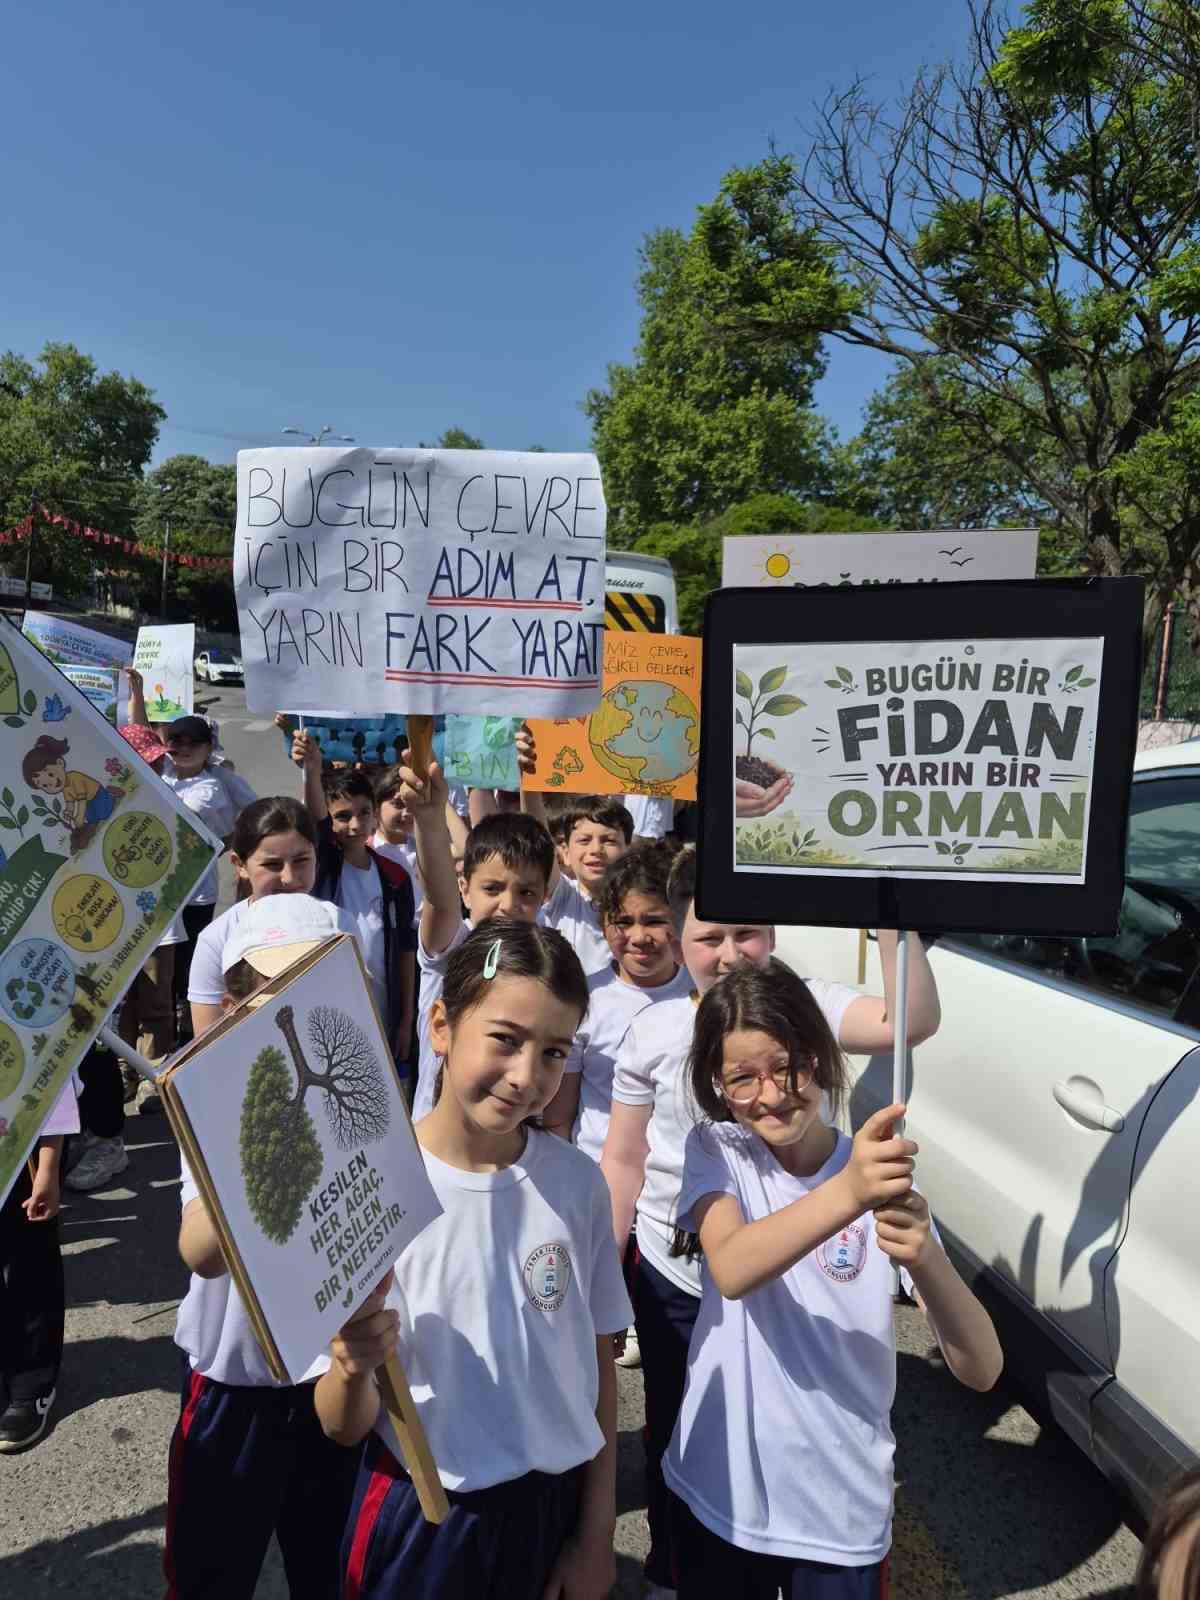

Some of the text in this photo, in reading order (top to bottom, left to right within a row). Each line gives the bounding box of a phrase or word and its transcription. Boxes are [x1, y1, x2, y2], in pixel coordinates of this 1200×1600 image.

[248, 462, 601, 542] BUGÜN ÇEVRE
[244, 536, 598, 606] İÇİN BİR ADIM AT,
[248, 608, 606, 678] YARIN FARK YARAT
[605, 640, 640, 657] MİZ
[865, 656, 1051, 697] BUGÜN BİR
[837, 697, 1084, 762] FİDAN
[876, 757, 1041, 788] YARIN BİR
[827, 789, 1086, 840] ORMAN
[0, 880, 17, 903] RU,
[23, 871, 46, 898] ÇIK!
[55, 1039, 71, 1059] BİR
[309, 1150, 368, 1223] KESİLEN
[310, 1167, 384, 1254] HER AĞAÇ,
[314, 1202, 407, 1313] BİR NEFESTİR.
[326, 1195, 382, 1268] EKSİLEN
